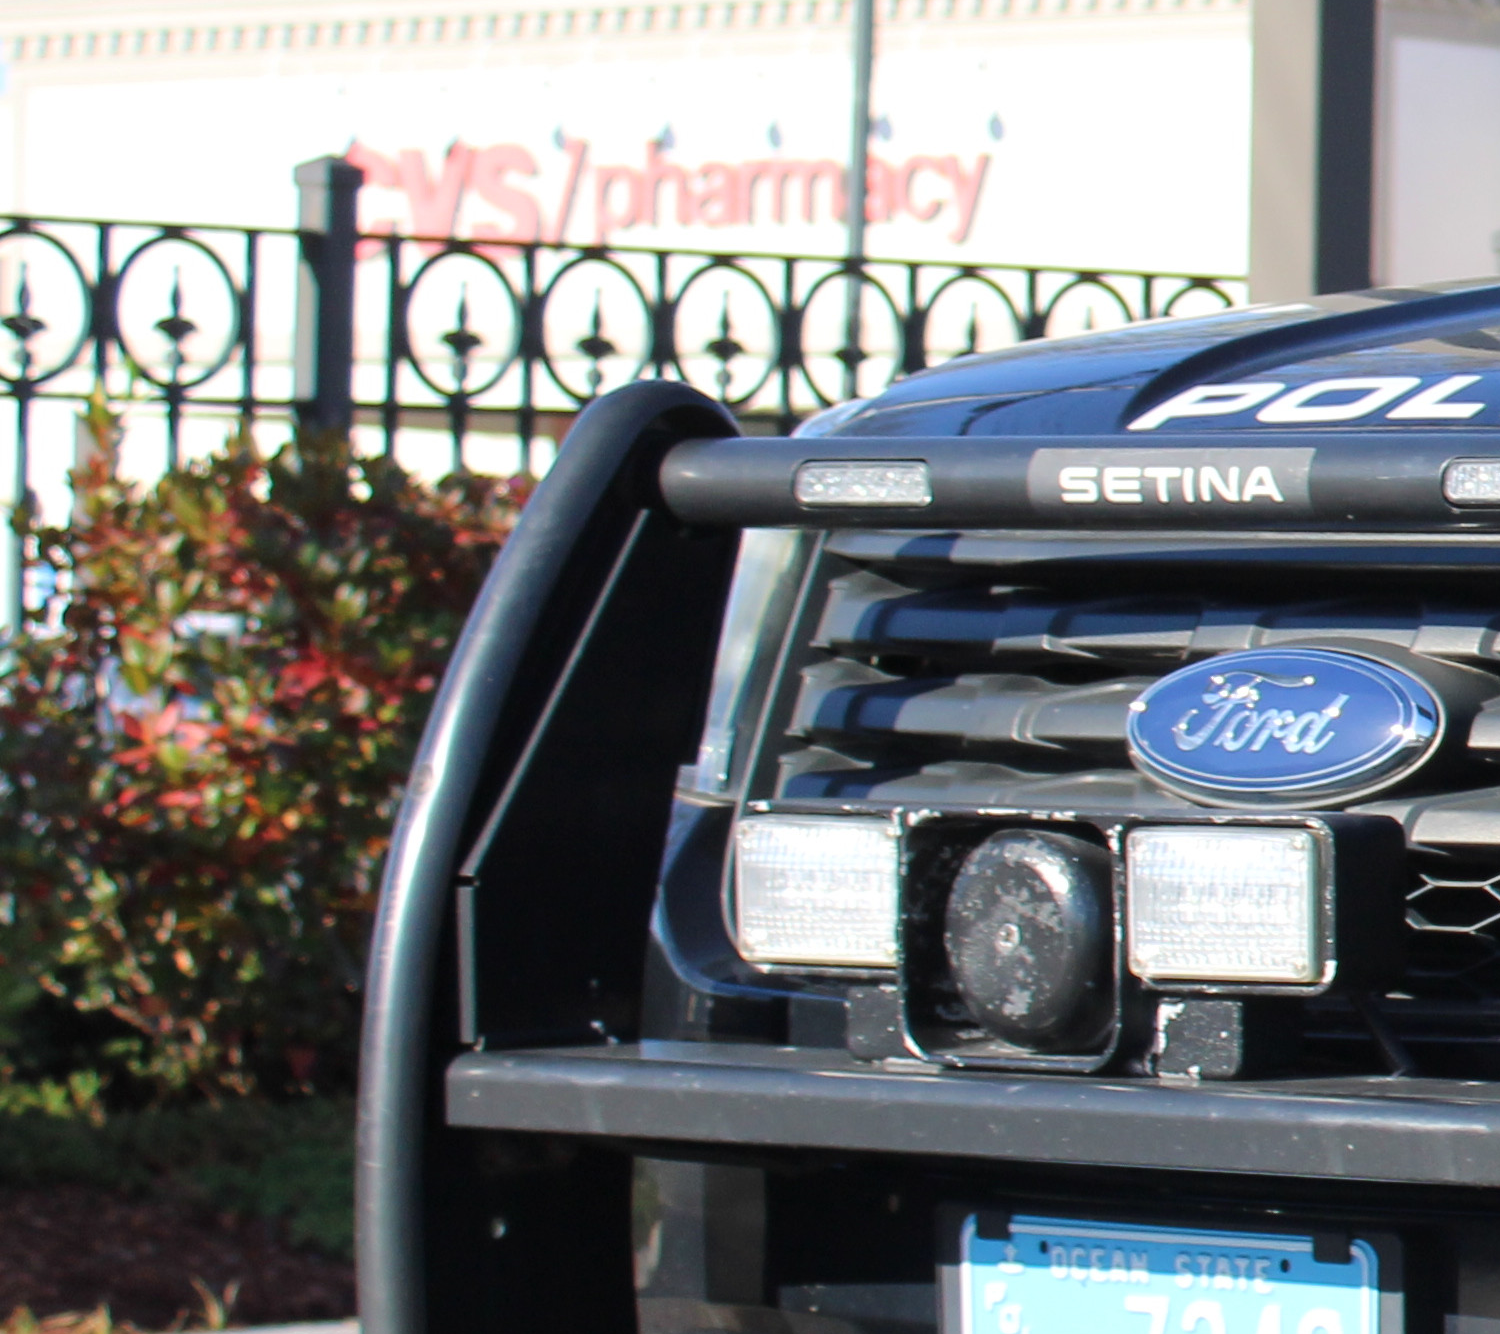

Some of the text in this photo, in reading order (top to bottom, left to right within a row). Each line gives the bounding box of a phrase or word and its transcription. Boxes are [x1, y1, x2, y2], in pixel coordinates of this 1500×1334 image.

[1058, 466, 1285, 504] SETINA
[1171, 670, 1350, 754] Ford
[1050, 1244, 1274, 1294] OCEAN STATE
